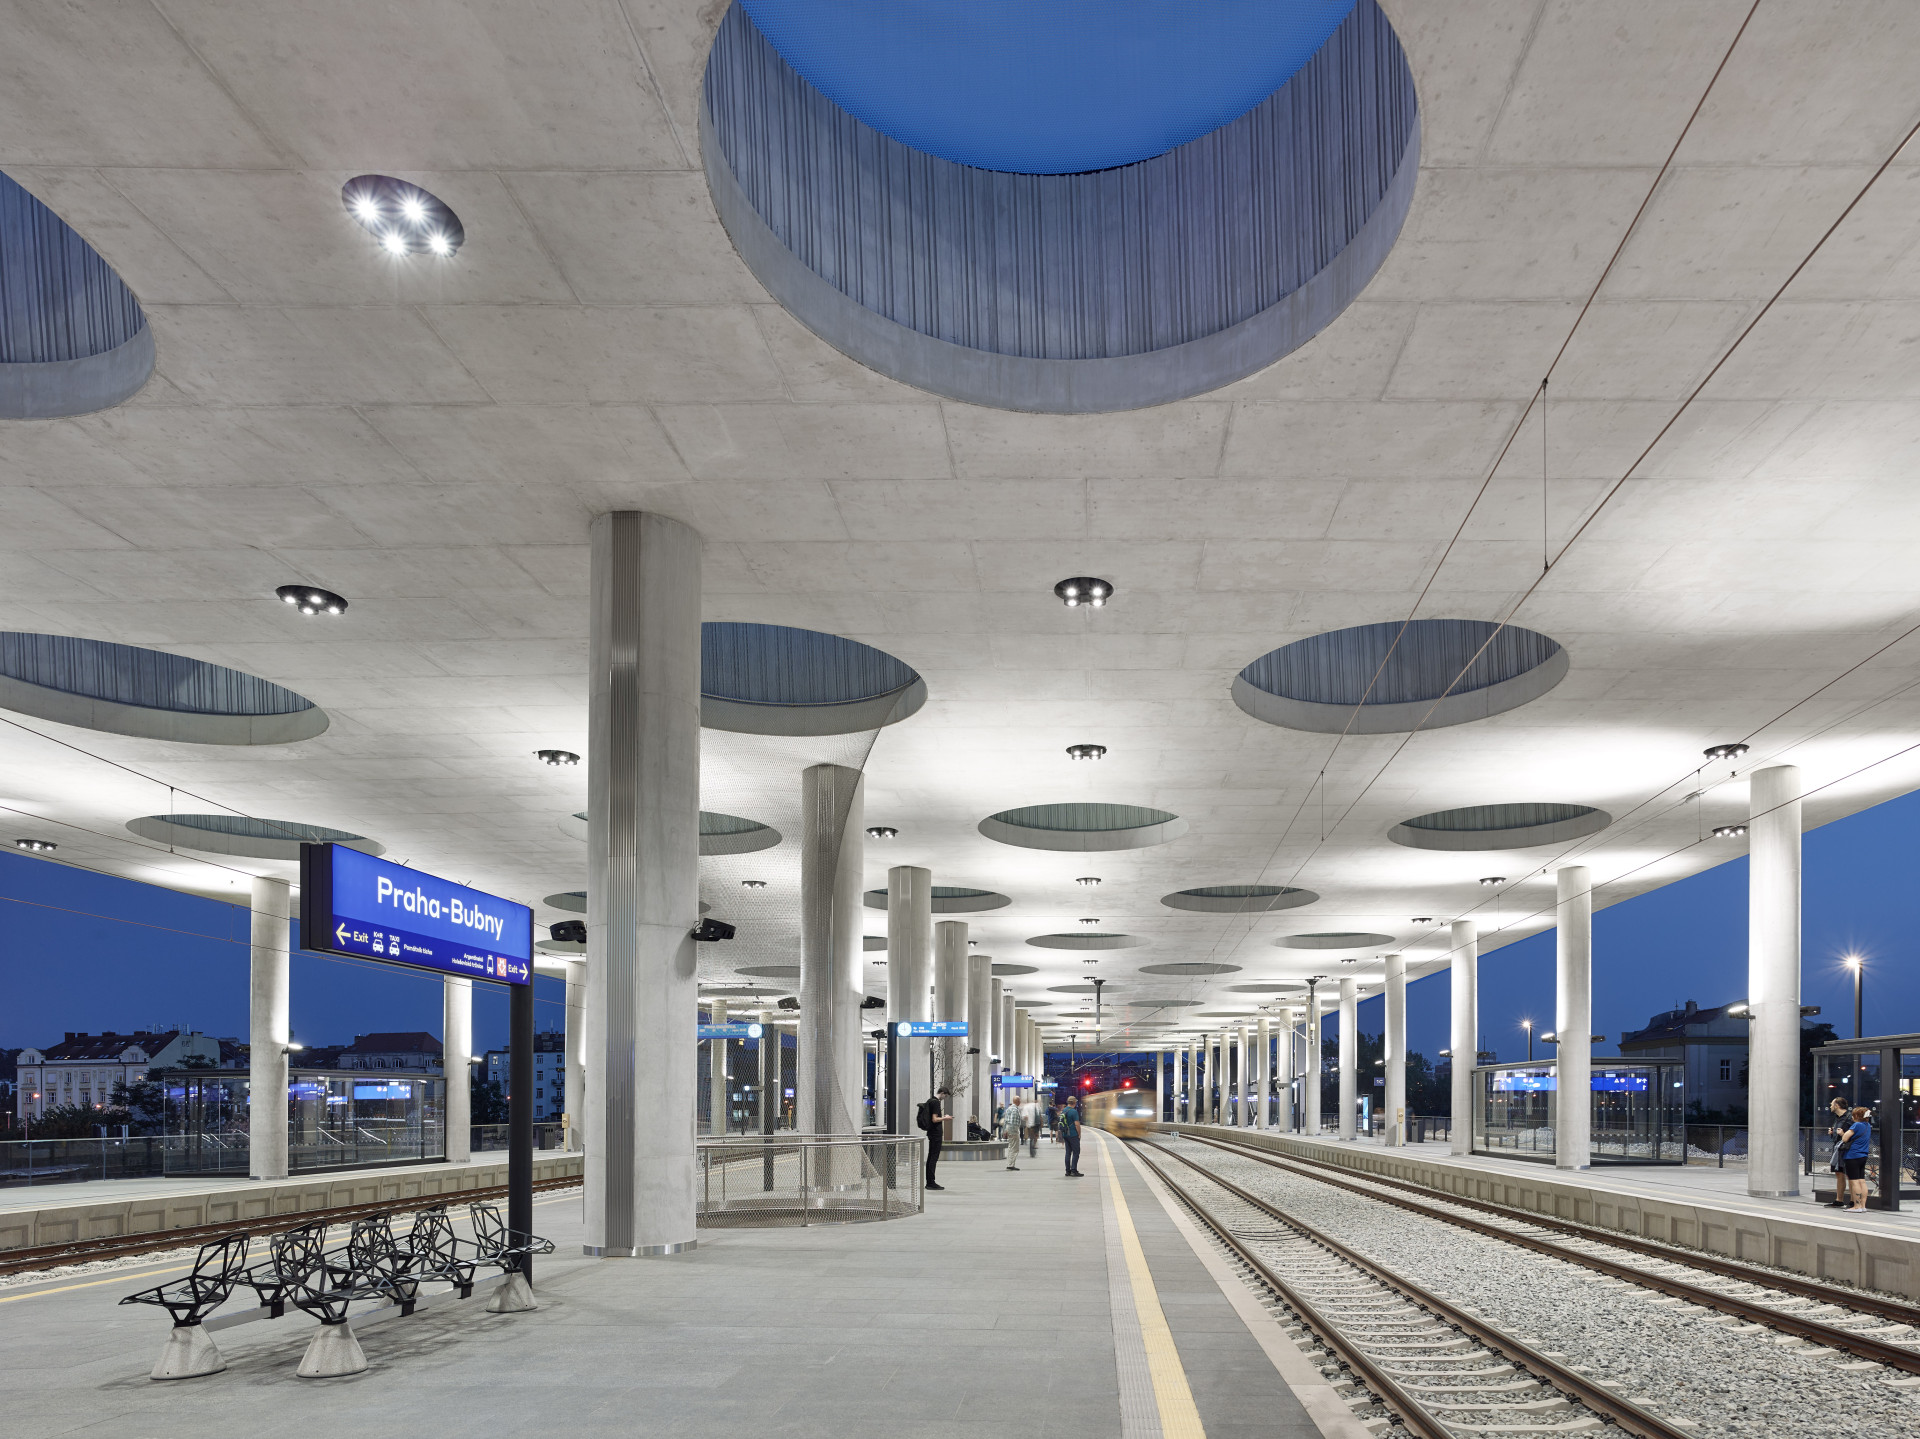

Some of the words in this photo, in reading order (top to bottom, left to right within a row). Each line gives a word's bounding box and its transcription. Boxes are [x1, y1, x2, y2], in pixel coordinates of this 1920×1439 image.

[377, 875, 504, 941] Praha-Bubny
[353, 930, 369, 944] Exit
[388, 934, 400, 943] TAXI
[508, 963, 518, 974] Exit
